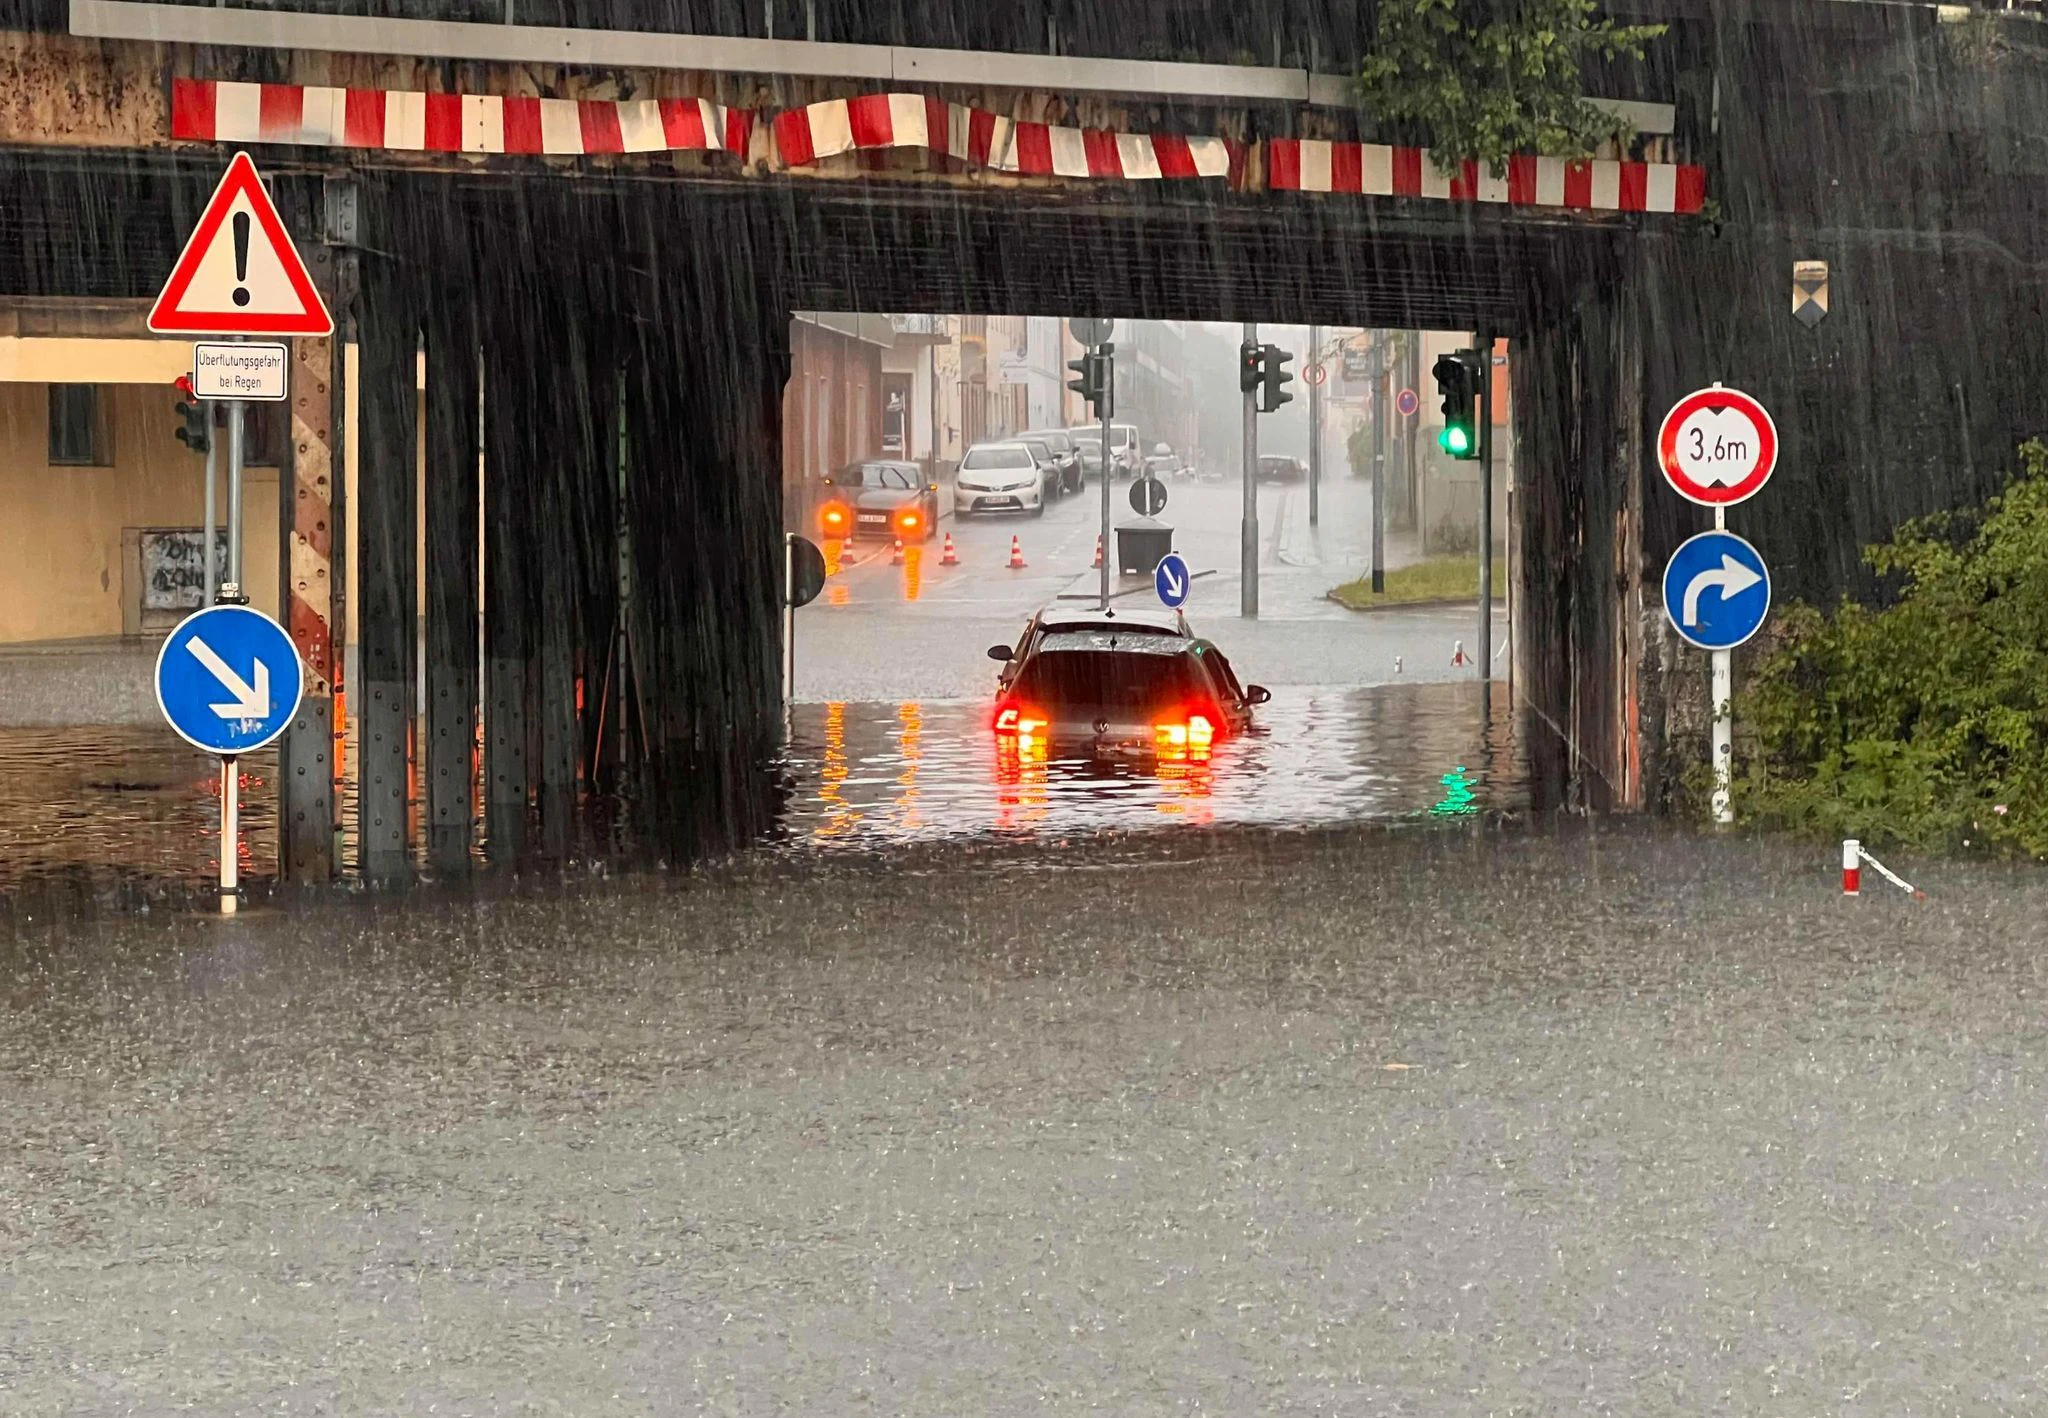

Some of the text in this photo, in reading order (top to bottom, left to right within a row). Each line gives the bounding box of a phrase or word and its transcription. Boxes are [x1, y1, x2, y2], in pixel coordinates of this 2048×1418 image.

[199, 350, 281, 370] Überflutungsgefahr
[219, 375, 262, 391] bei Regen
[1690, 427, 1747, 464] 3,6m
